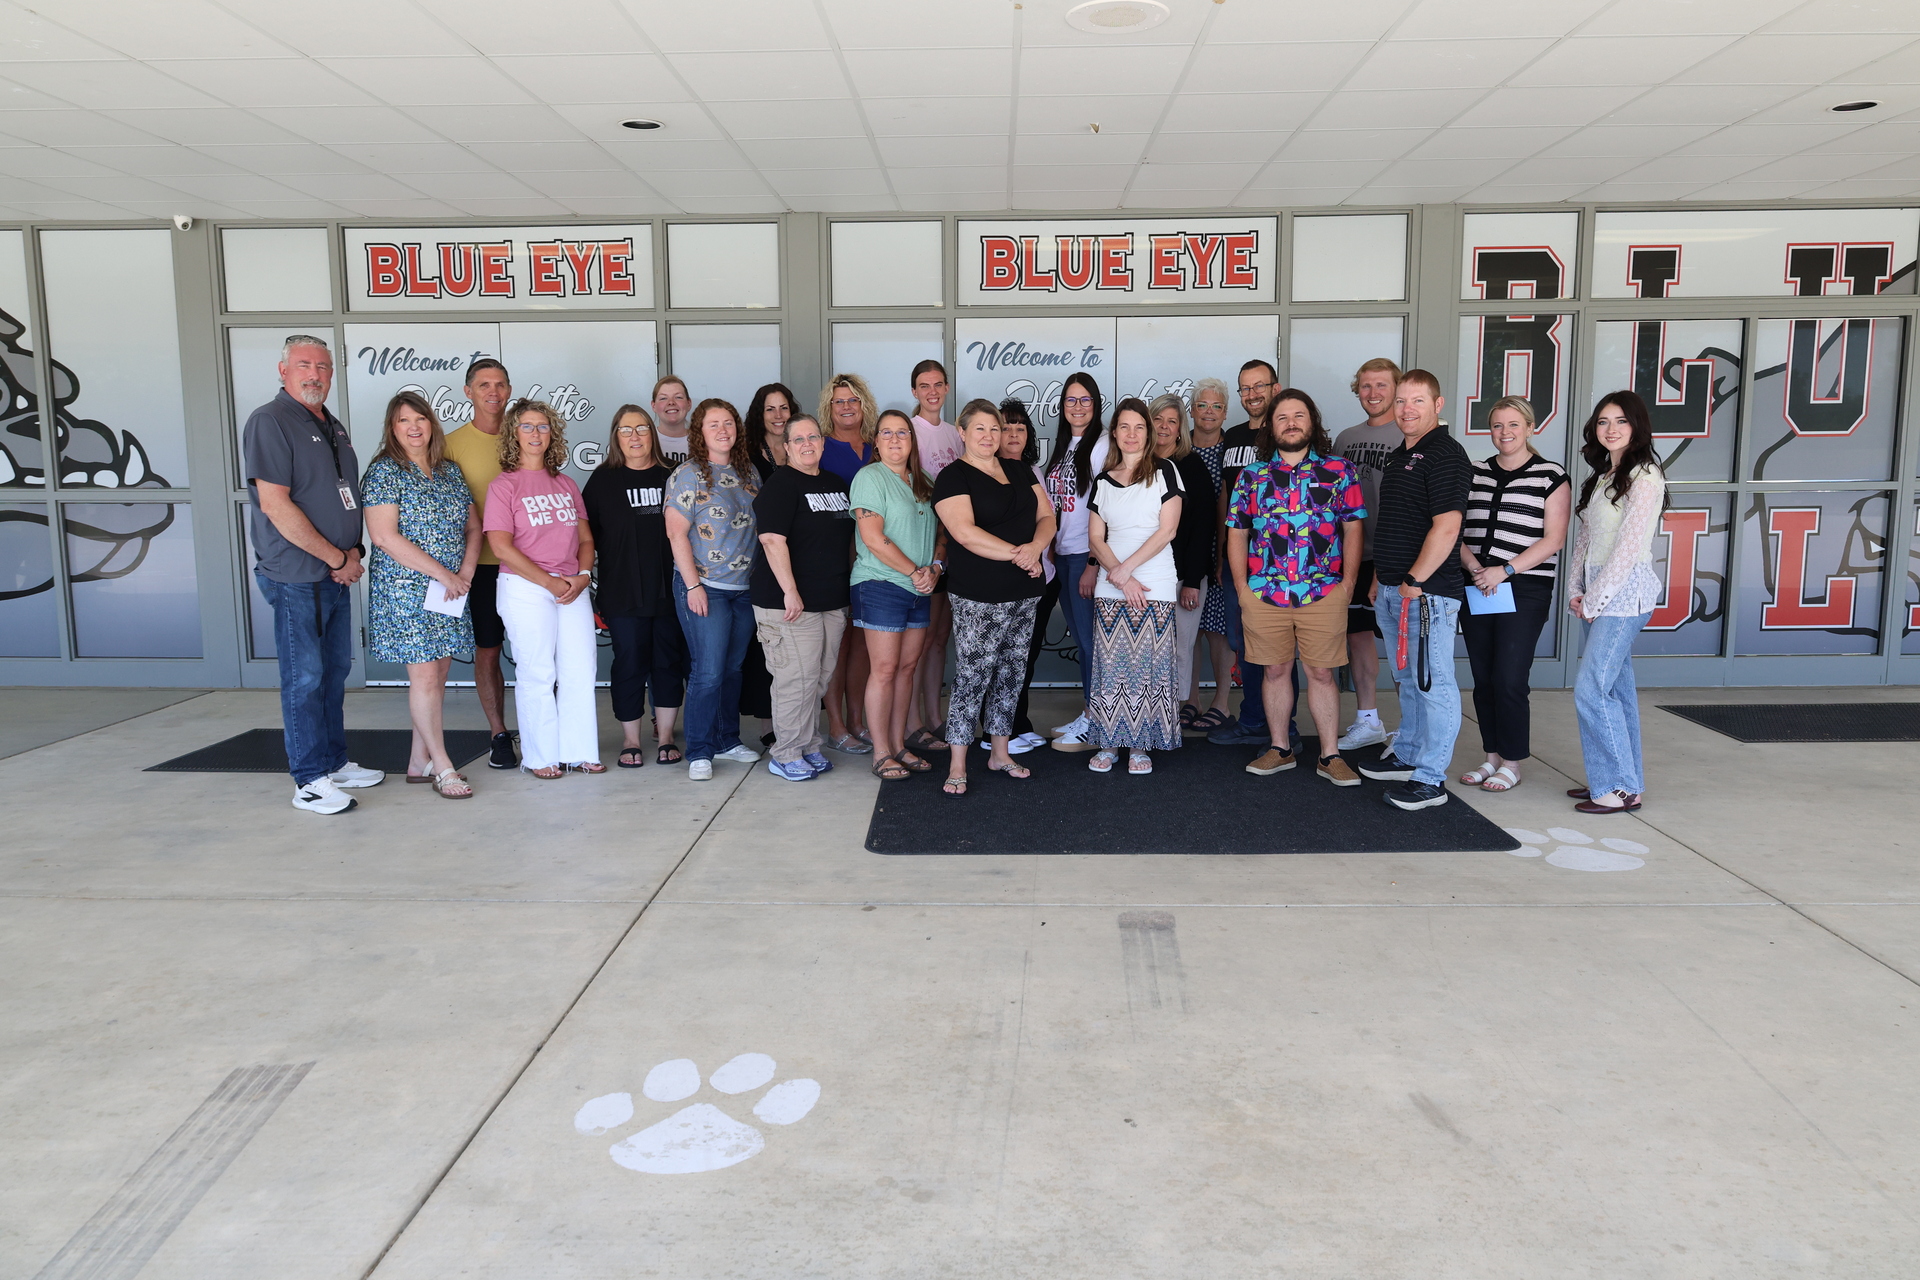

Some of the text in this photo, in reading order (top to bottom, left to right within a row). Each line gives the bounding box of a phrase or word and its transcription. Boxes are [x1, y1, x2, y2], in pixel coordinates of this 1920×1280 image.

[364, 237, 635, 299] BLUE EYE
[980, 230, 1259, 292] BLUE EYE
[358, 346, 464, 376] Welcome
[966, 341, 1104, 371] Welcome to
[396, 383, 475, 422] Hom
[1351, 442, 1386, 450] BLUE EYE
[521, 492, 575, 513] BRUH
[528, 507, 578, 527] WE OU
